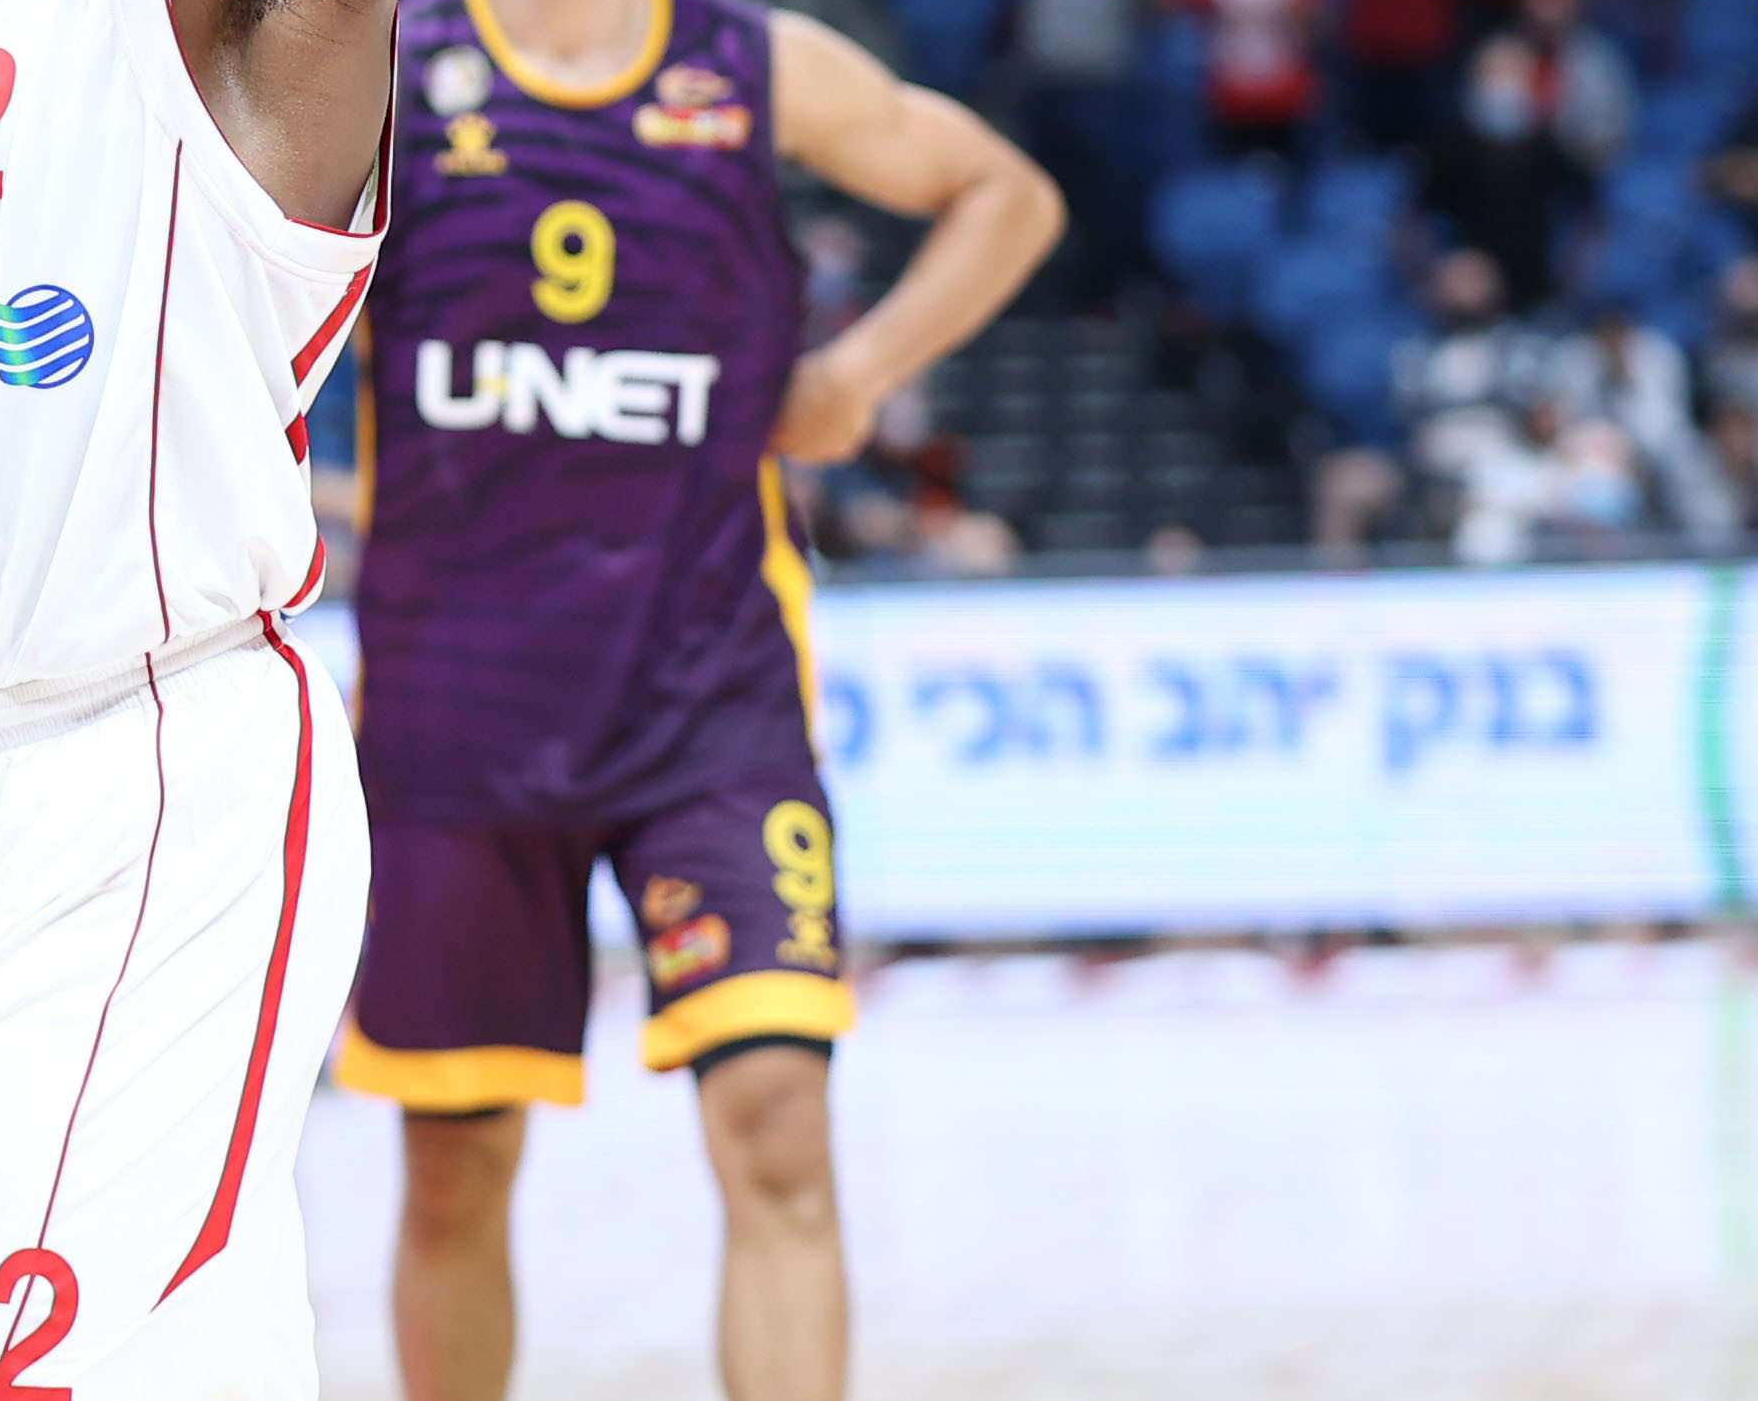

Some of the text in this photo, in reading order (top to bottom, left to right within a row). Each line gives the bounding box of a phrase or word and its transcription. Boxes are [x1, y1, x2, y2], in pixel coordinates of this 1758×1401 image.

[531, 200, 616, 324] 9
[415, 339, 721, 446] UNET
[1382, 648, 1602, 776] בנק
[762, 800, 834, 913] 9
